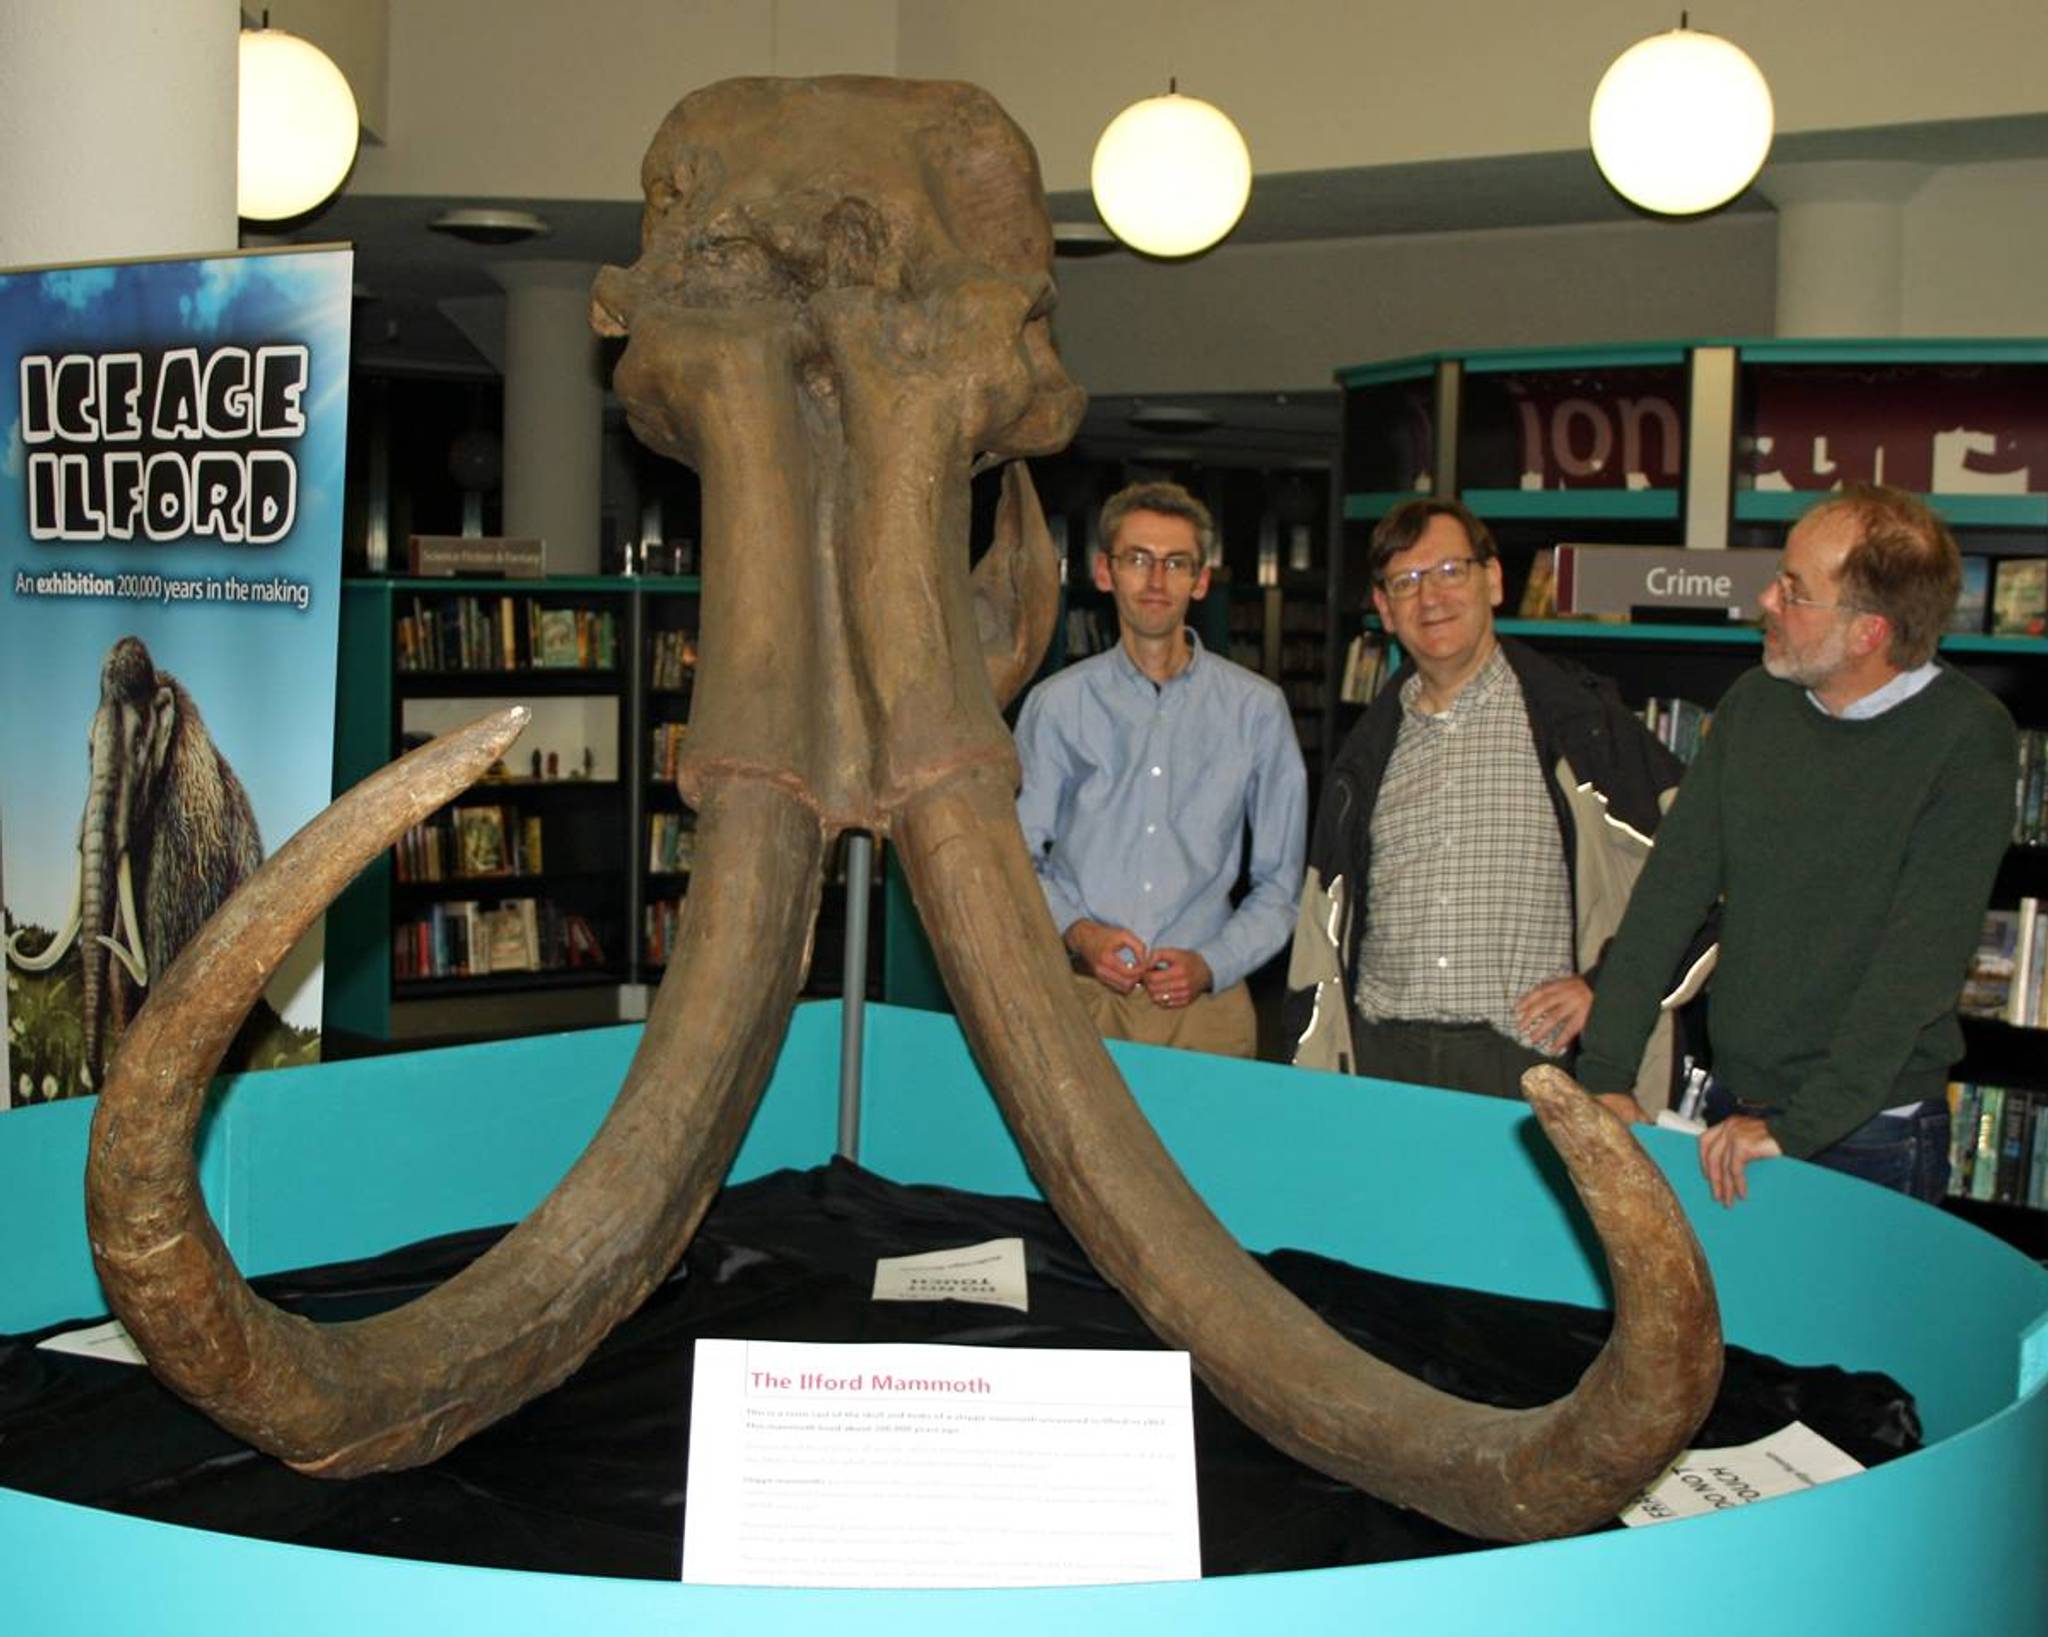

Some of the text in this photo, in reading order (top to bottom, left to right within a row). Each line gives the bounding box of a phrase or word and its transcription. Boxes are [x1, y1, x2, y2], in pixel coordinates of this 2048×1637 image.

[21, 345, 308, 443] ICE AGE
[28, 450, 297, 543] ILFORD
[15, 571, 309, 609] An exhibition 200,000 years in the making
[1646, 567, 1732, 597] Crime
[751, 1372, 992, 1394] The Ilford Mammoth
